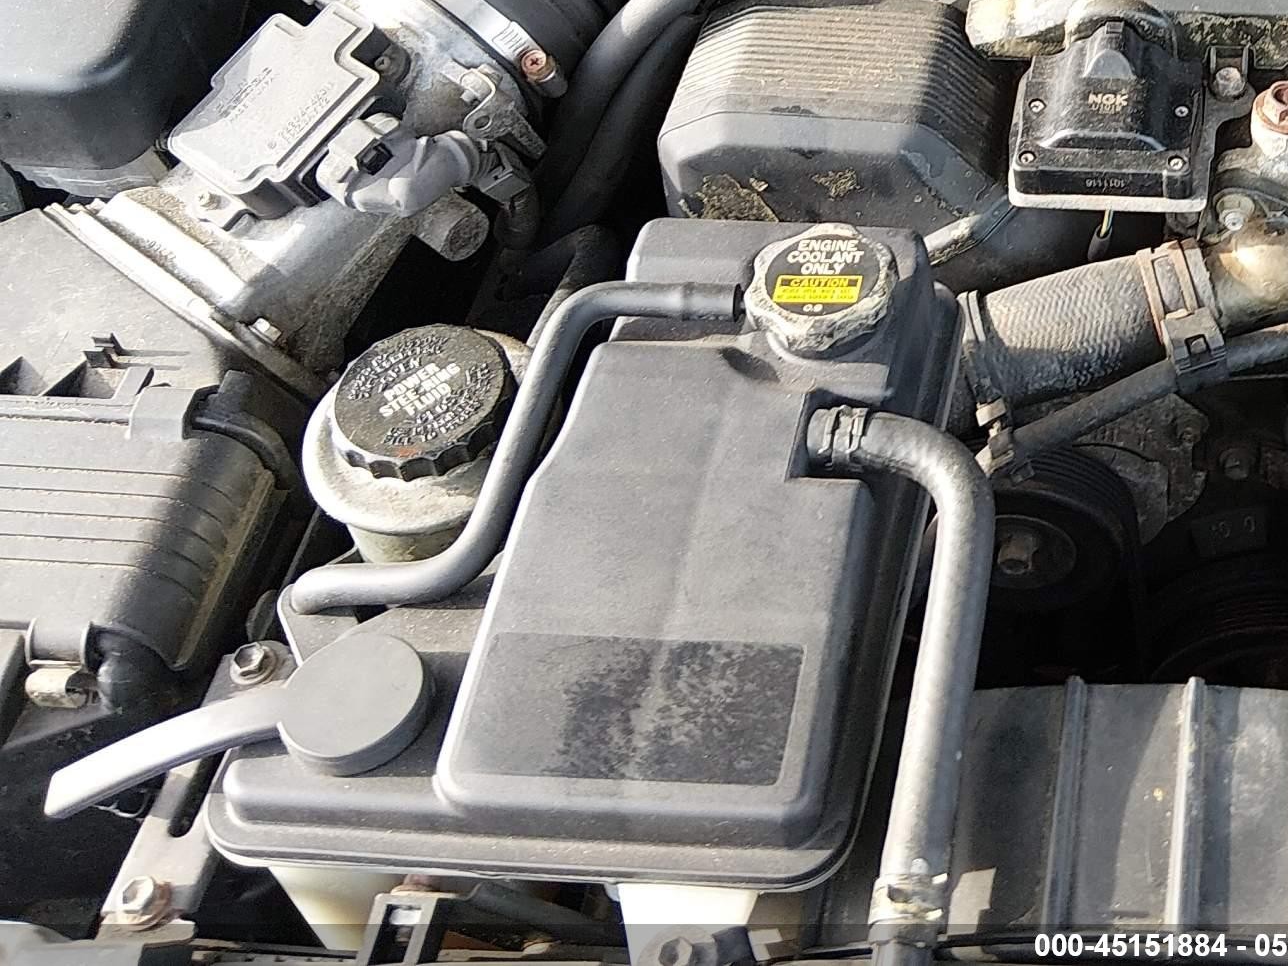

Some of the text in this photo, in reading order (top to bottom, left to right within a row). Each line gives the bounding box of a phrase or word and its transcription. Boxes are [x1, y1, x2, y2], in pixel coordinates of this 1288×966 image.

[1088, 93, 1129, 107] NGK
[798, 239, 859, 251] ENGINE
[786, 250, 865, 263] COOLANT
[800, 262, 845, 275] ONLY
[790, 278, 848, 287] CAUTION
[383, 362, 441, 402] POWER
[403, 383, 451, 416] FLUID
